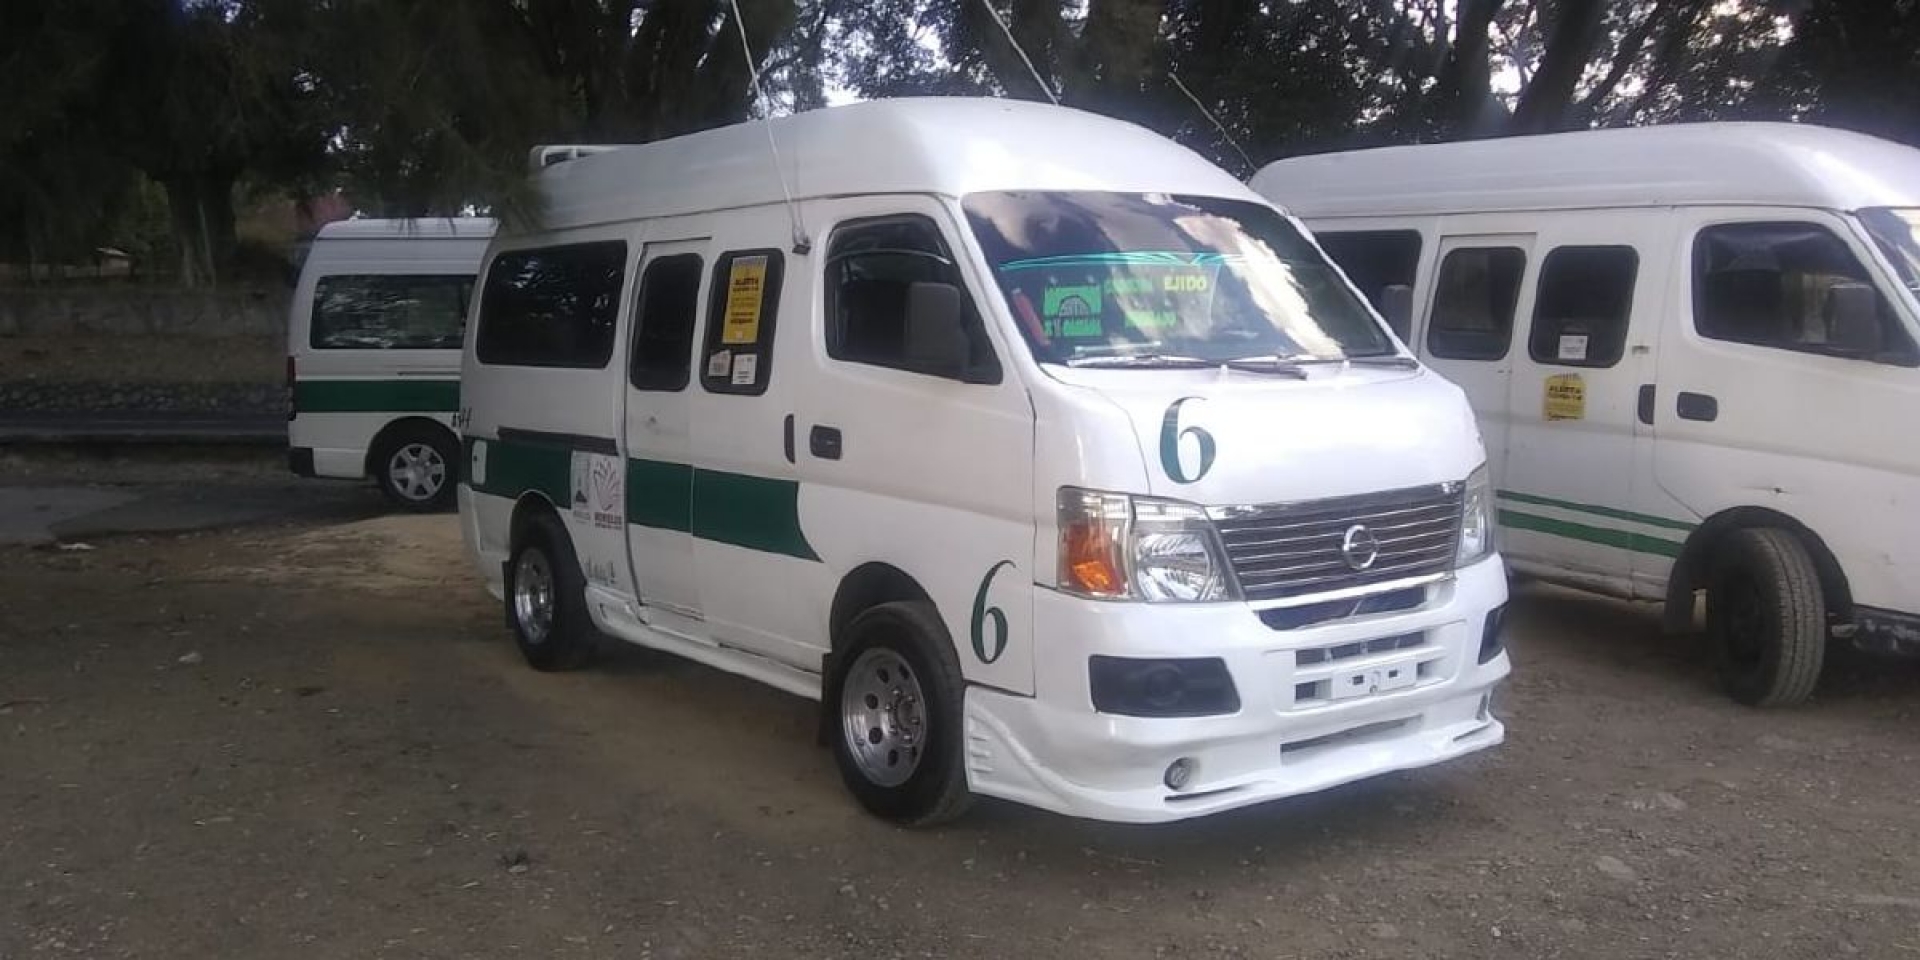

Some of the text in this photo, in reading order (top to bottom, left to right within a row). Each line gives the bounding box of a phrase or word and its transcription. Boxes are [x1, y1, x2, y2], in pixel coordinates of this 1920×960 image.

[1164, 274, 1208, 292] EJIDO
[1160, 396, 1216, 485] 6
[971, 560, 1016, 664] 6
